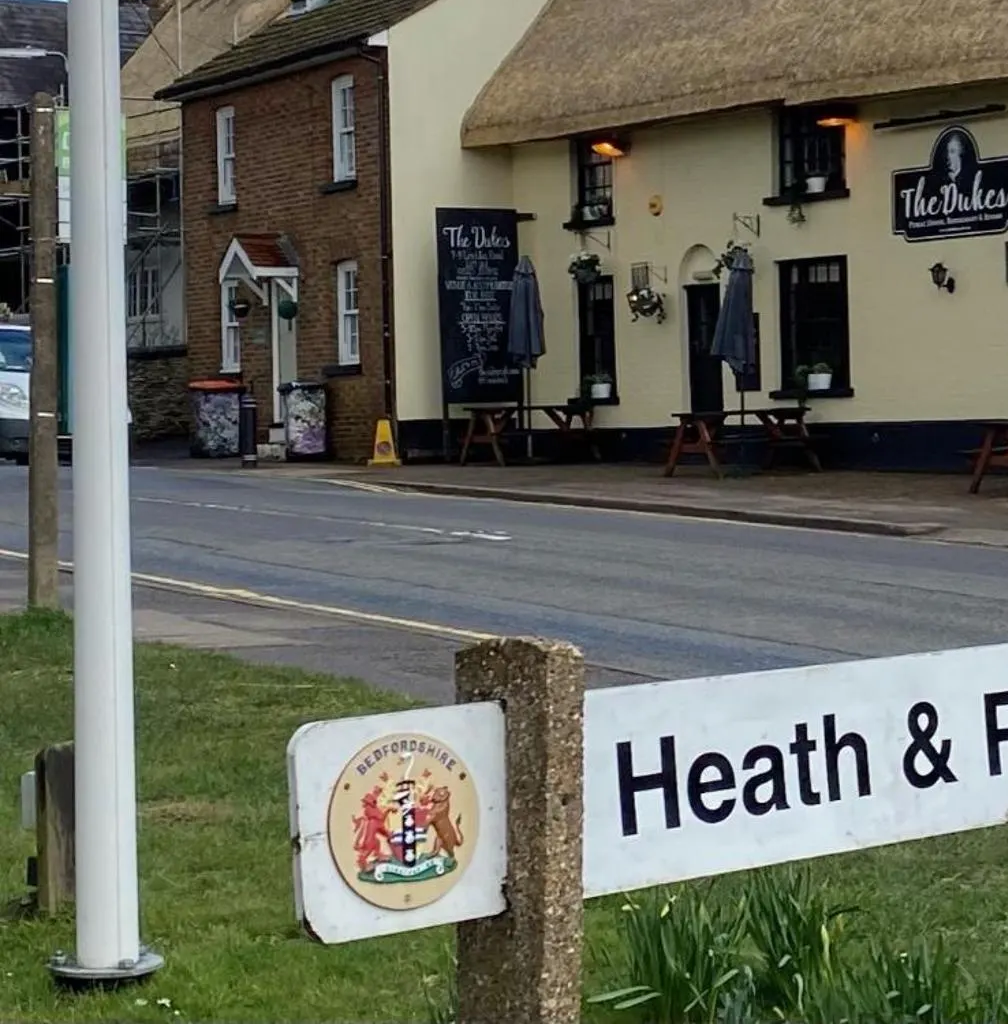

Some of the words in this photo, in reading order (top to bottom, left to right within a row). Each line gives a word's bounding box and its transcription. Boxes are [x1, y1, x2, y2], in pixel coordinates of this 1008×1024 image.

[900, 176, 942, 218] The
[442, 224, 471, 248] The
[471, 225, 511, 249] Dukes
[356, 739, 457, 776] BEDFORDSHIRE
[617, 714, 871, 836] Heath
[903, 701, 957, 788] &
